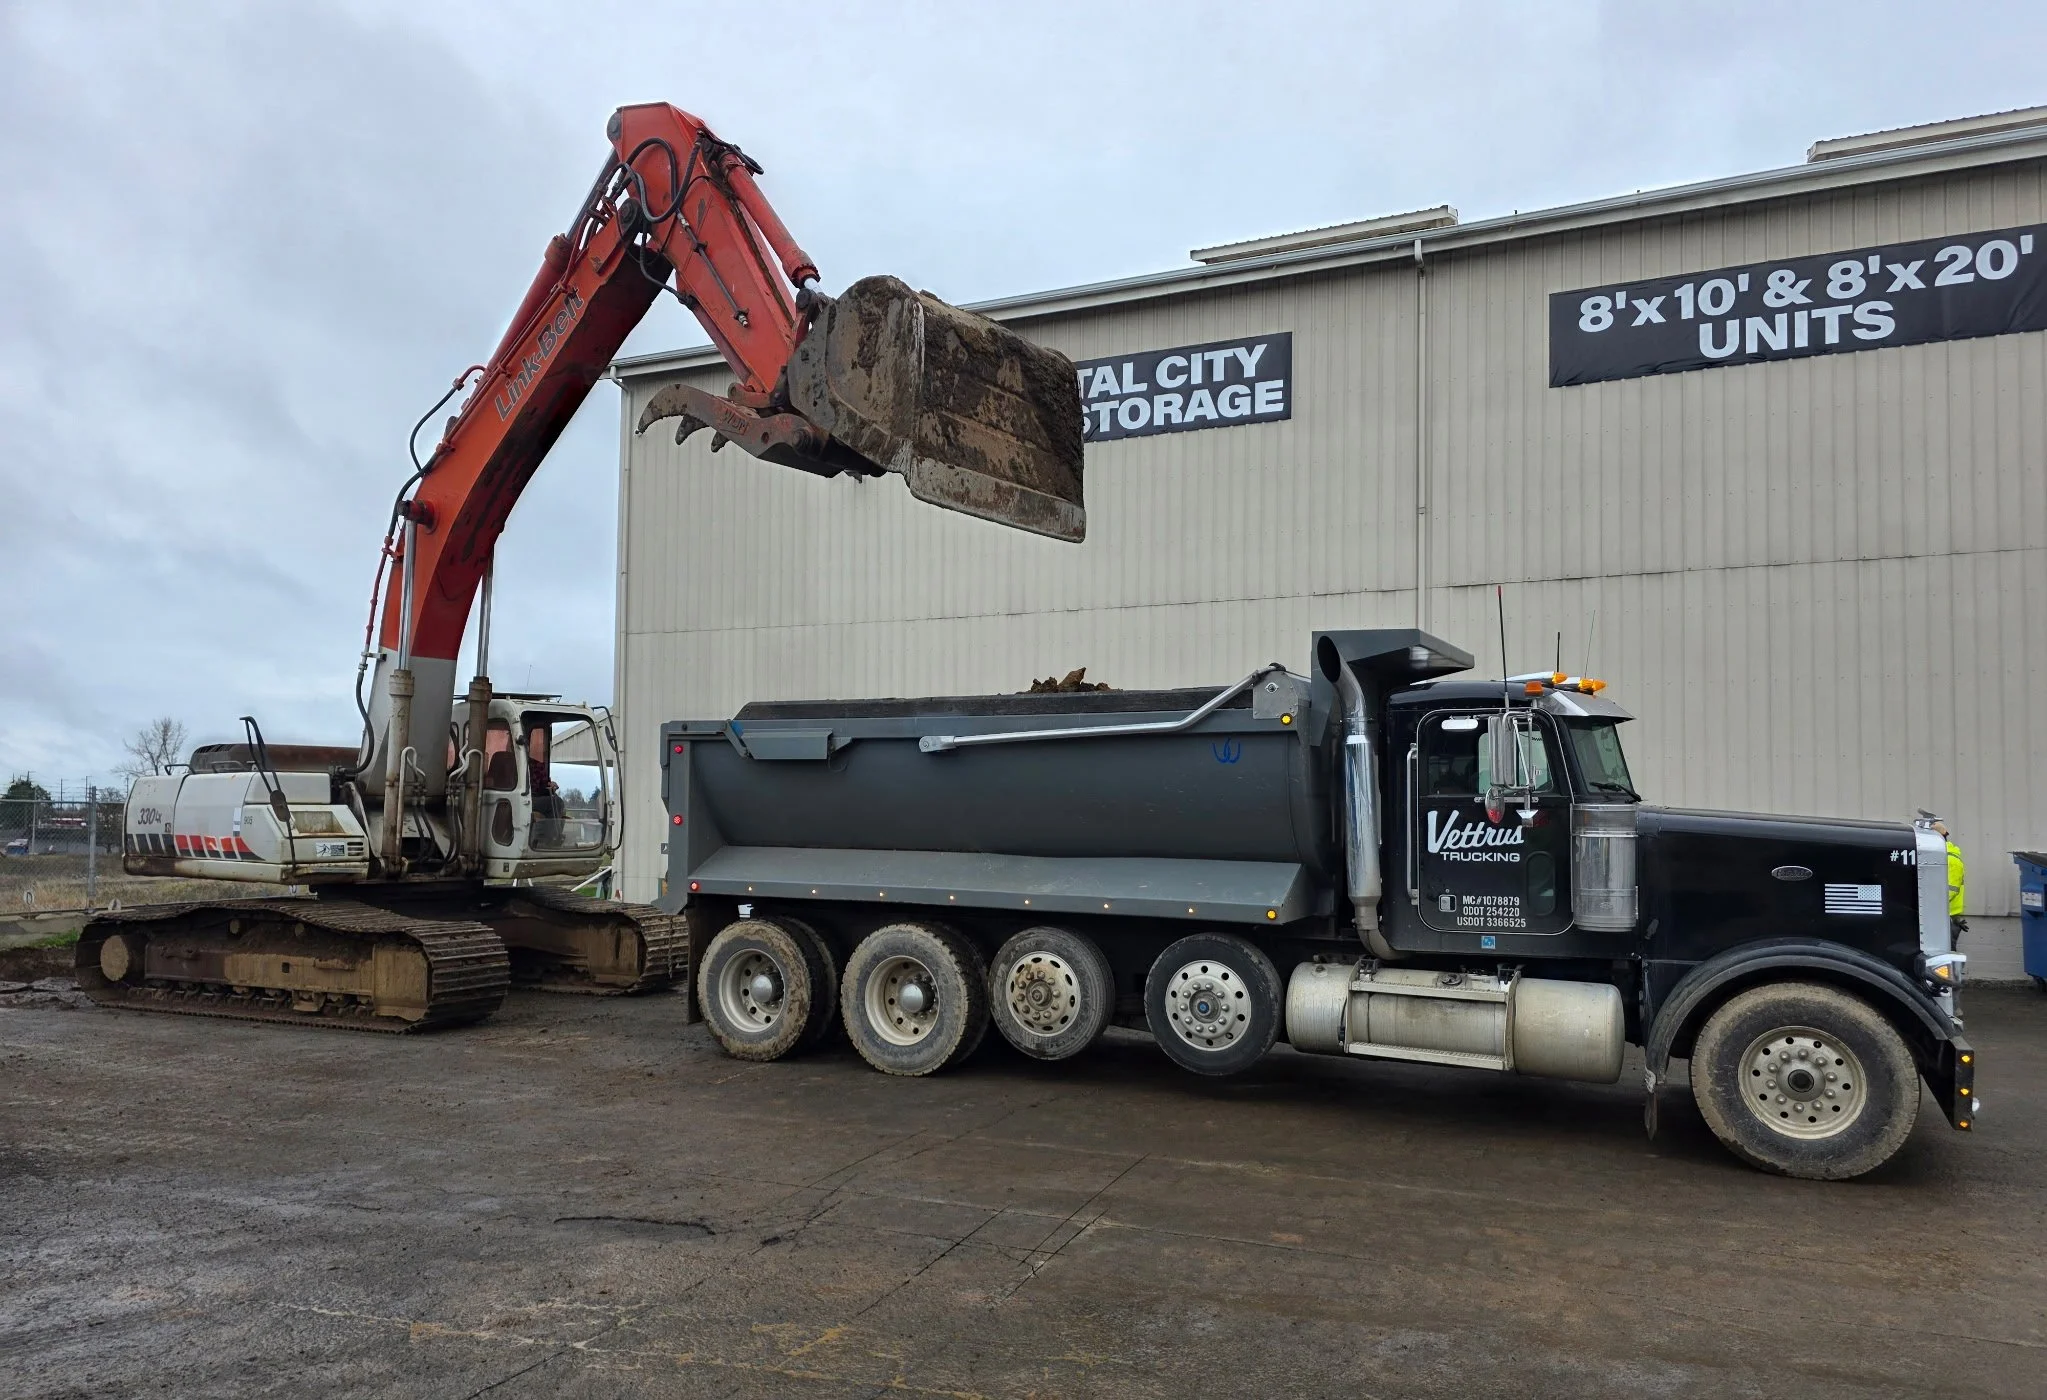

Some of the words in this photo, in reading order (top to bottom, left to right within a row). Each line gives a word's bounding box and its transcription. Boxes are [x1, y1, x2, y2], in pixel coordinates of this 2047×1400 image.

[1762, 269, 1814, 309] &
[1698, 300, 1897, 360] UNITS
[494, 286, 585, 422] Link-Belt
[1155, 343, 1268, 389] CITY
[1082, 379, 1285, 435] TORAGE
[1427, 809, 1525, 854] Vettrus
[1440, 851, 1521, 863] TRUCKING
[1889, 849, 1916, 865] #11
[1462, 895, 1520, 906] MC#1078879
[1462, 906, 1484, 916] ODOT
[1486, 906, 1520, 917] 254220
[1456, 916, 1484, 927] USDOT
[1486, 917, 1527, 928] 3366525
